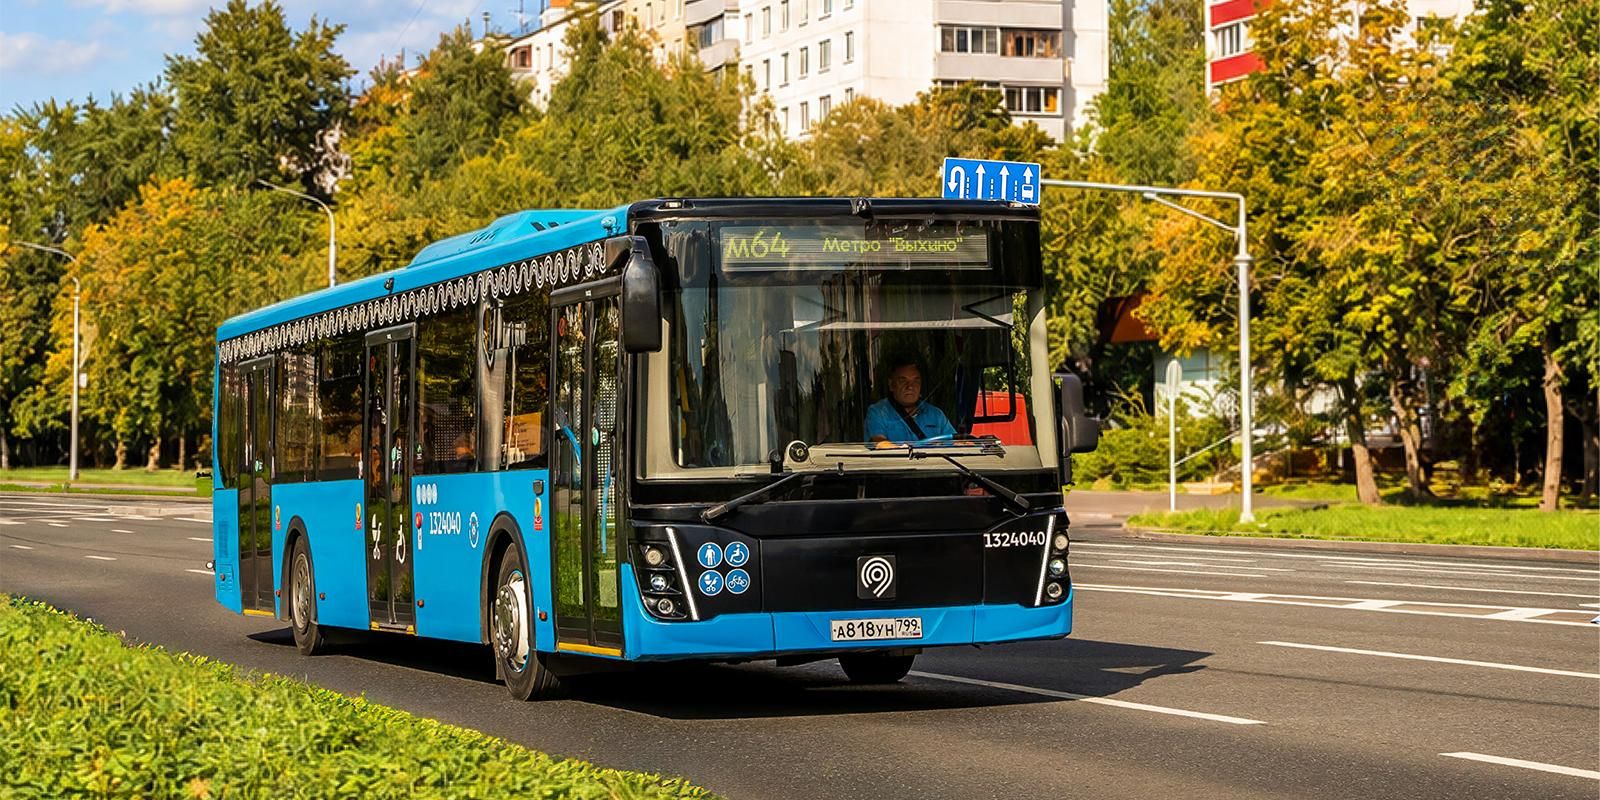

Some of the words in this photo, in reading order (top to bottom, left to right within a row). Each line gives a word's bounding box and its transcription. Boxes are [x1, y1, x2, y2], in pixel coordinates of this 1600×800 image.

[726, 230, 790, 258] М64
[822, 237, 881, 254] Метро
[429, 511, 461, 535] 1324040
[983, 531, 1046, 548] 1324040
